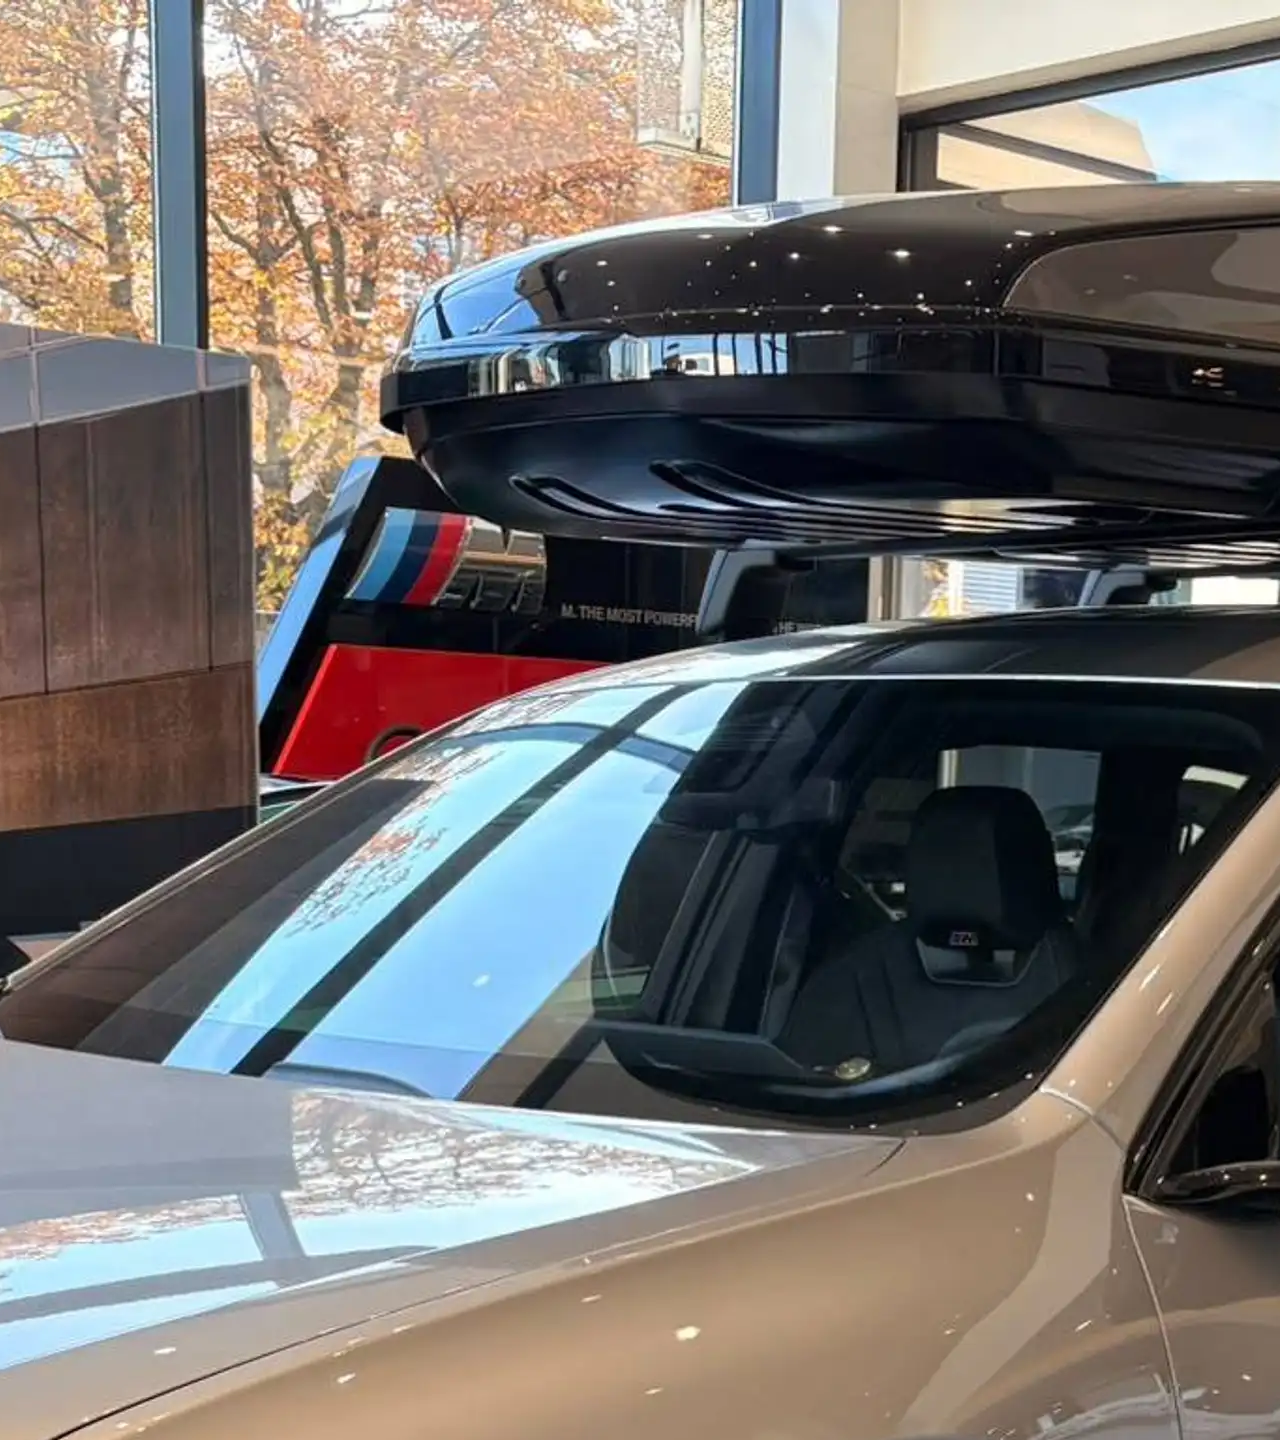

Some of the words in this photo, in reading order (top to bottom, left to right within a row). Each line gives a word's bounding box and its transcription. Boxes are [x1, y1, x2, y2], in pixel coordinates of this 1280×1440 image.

[579, 605, 605, 621] THE
[606, 608, 642, 624] MOST
[644, 610, 700, 628] POWERF
